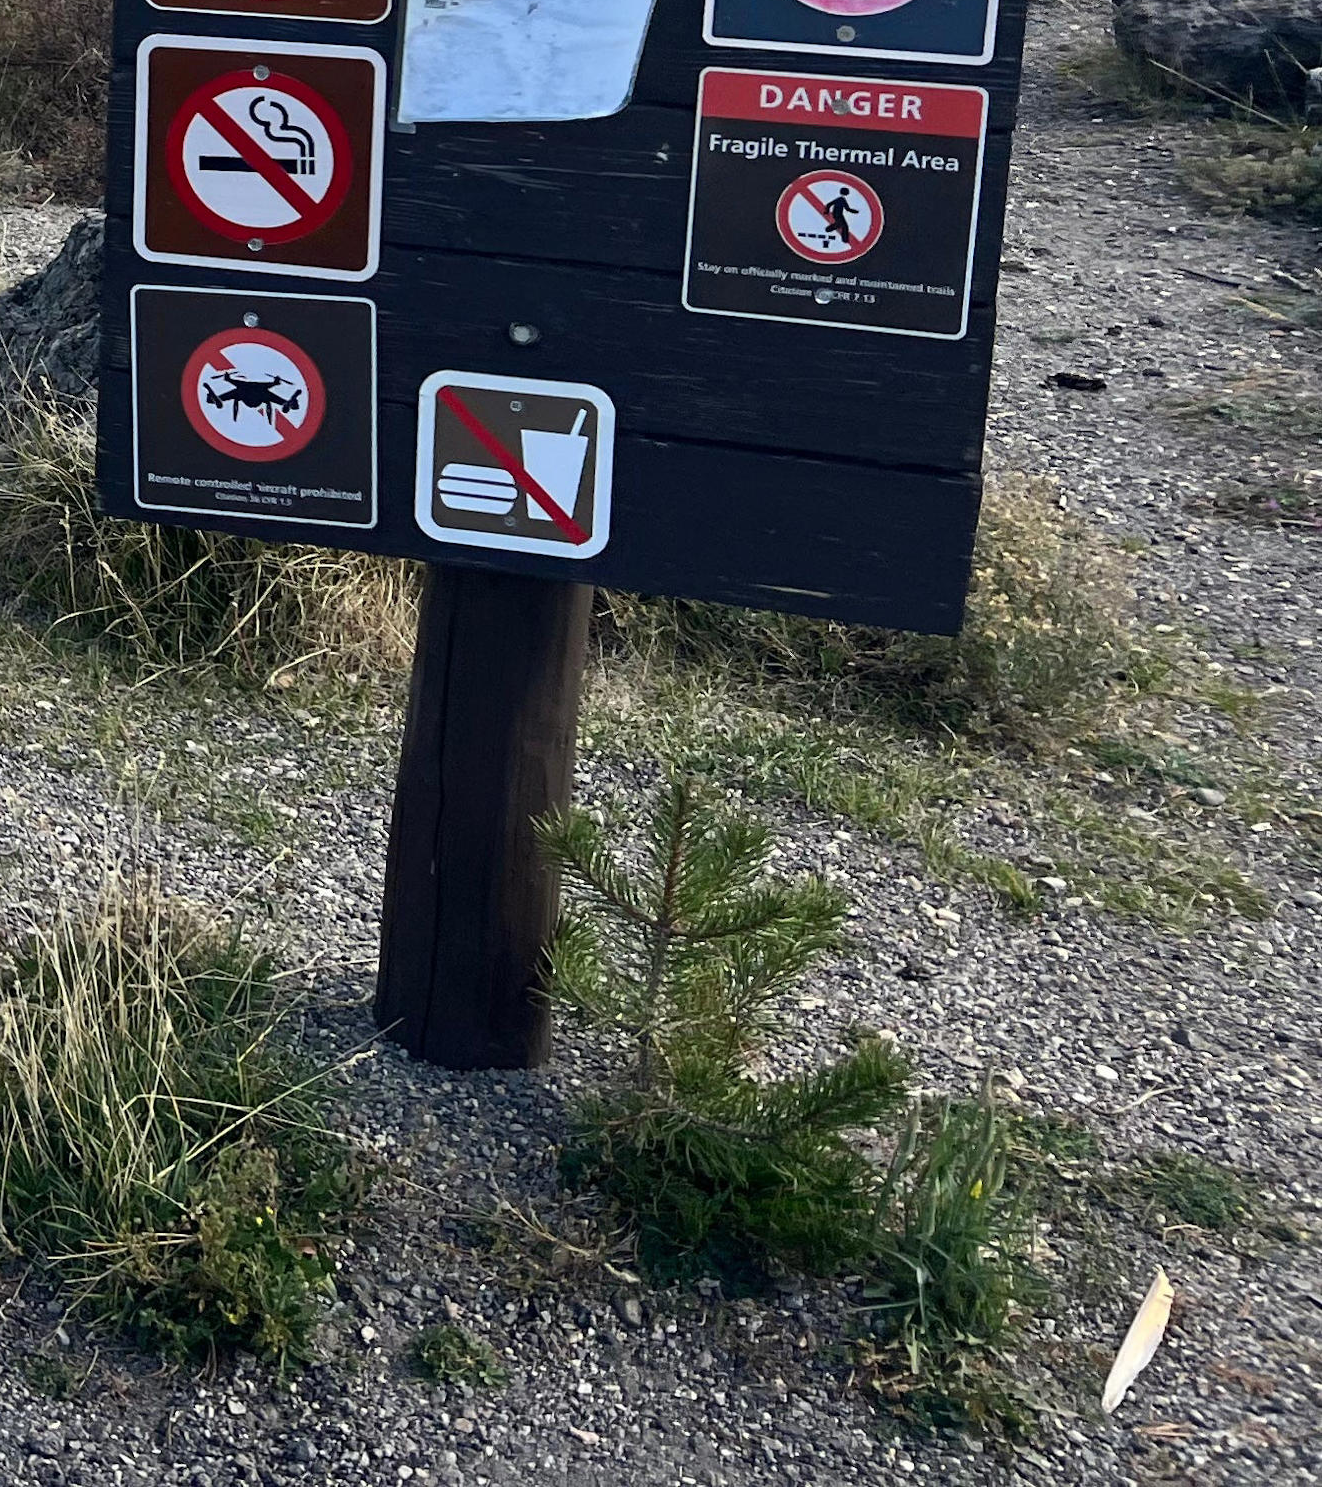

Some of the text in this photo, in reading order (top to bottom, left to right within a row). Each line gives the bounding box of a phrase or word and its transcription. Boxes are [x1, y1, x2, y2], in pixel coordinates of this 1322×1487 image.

[759, 84, 924, 120] DANGER
[708, 133, 960, 173] Fragile Thermal Area
[697, 261, 722, 275] Stay
